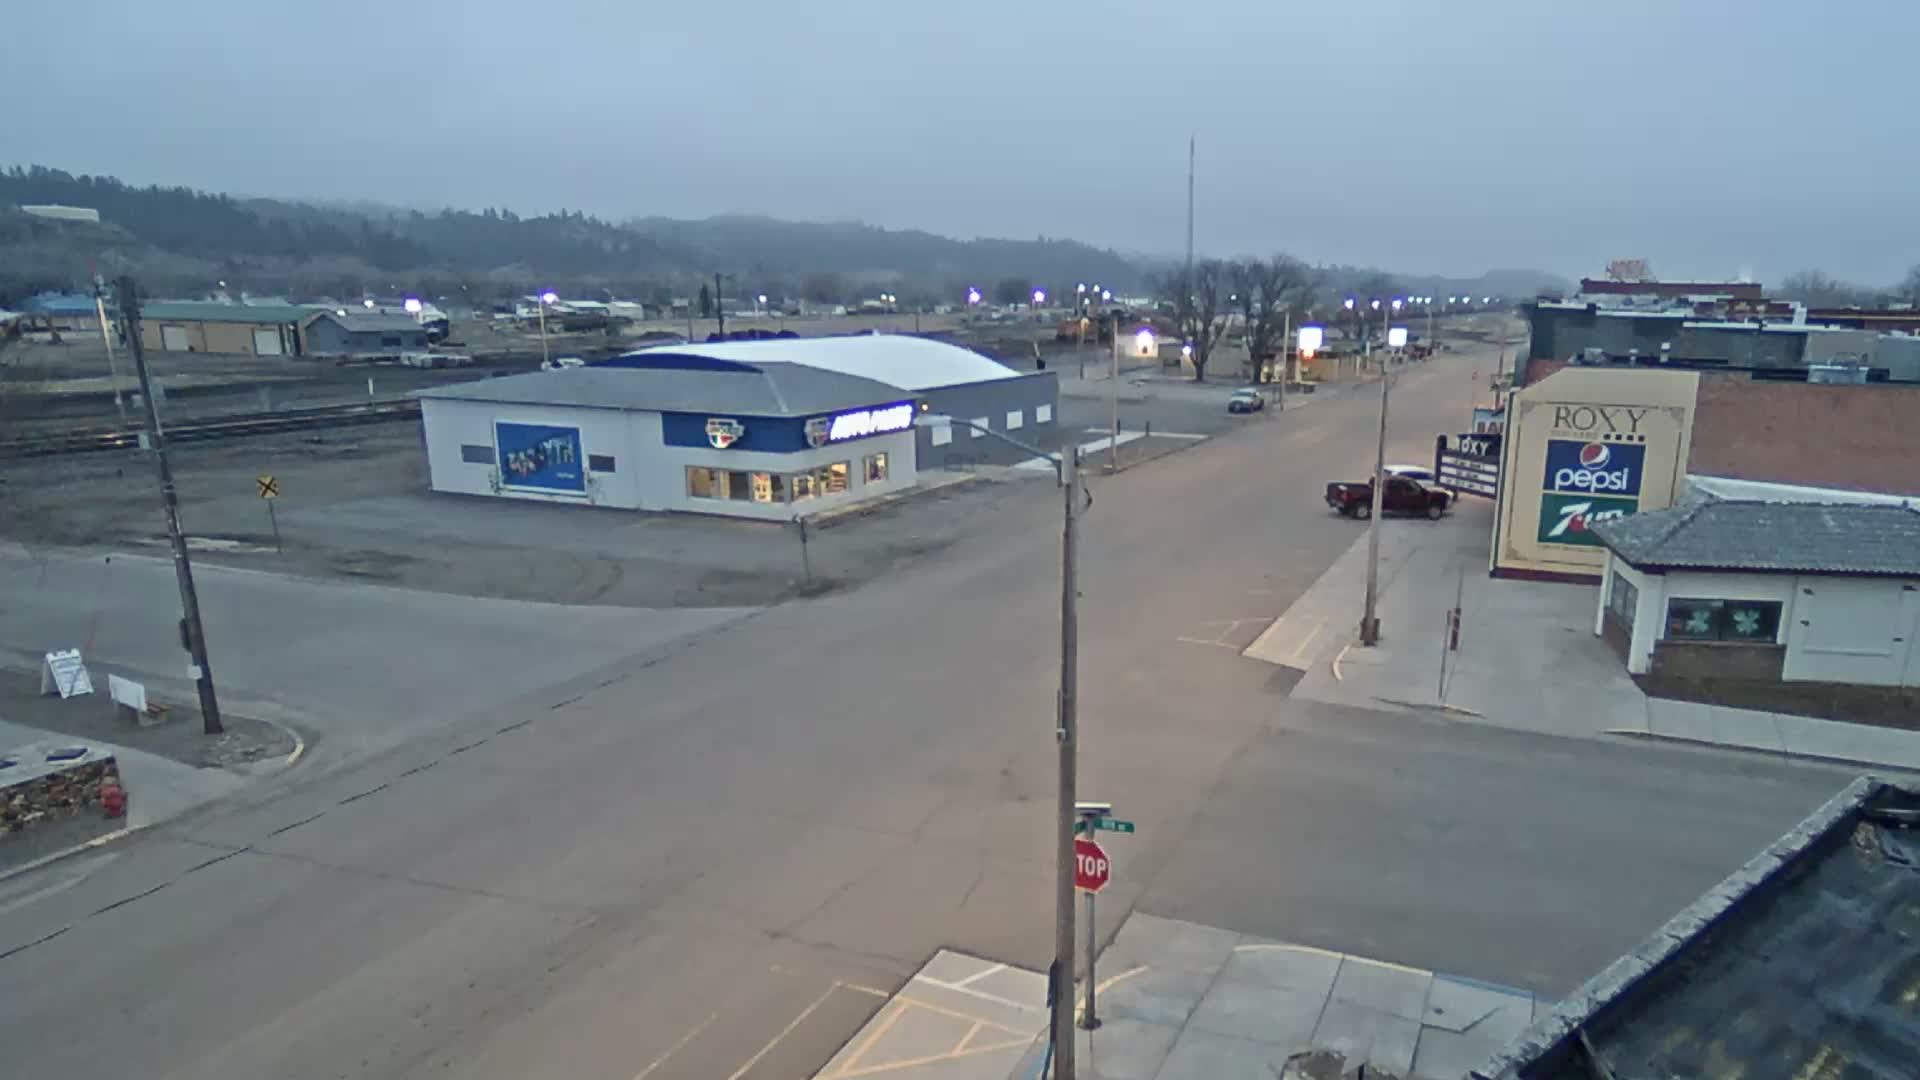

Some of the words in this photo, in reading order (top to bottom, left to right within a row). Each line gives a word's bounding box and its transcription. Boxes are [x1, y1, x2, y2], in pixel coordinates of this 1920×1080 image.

[1553, 405, 1647, 432] ROXY
[1554, 467, 1629, 493] pepsi
[1075, 854, 1106, 878] TOP
